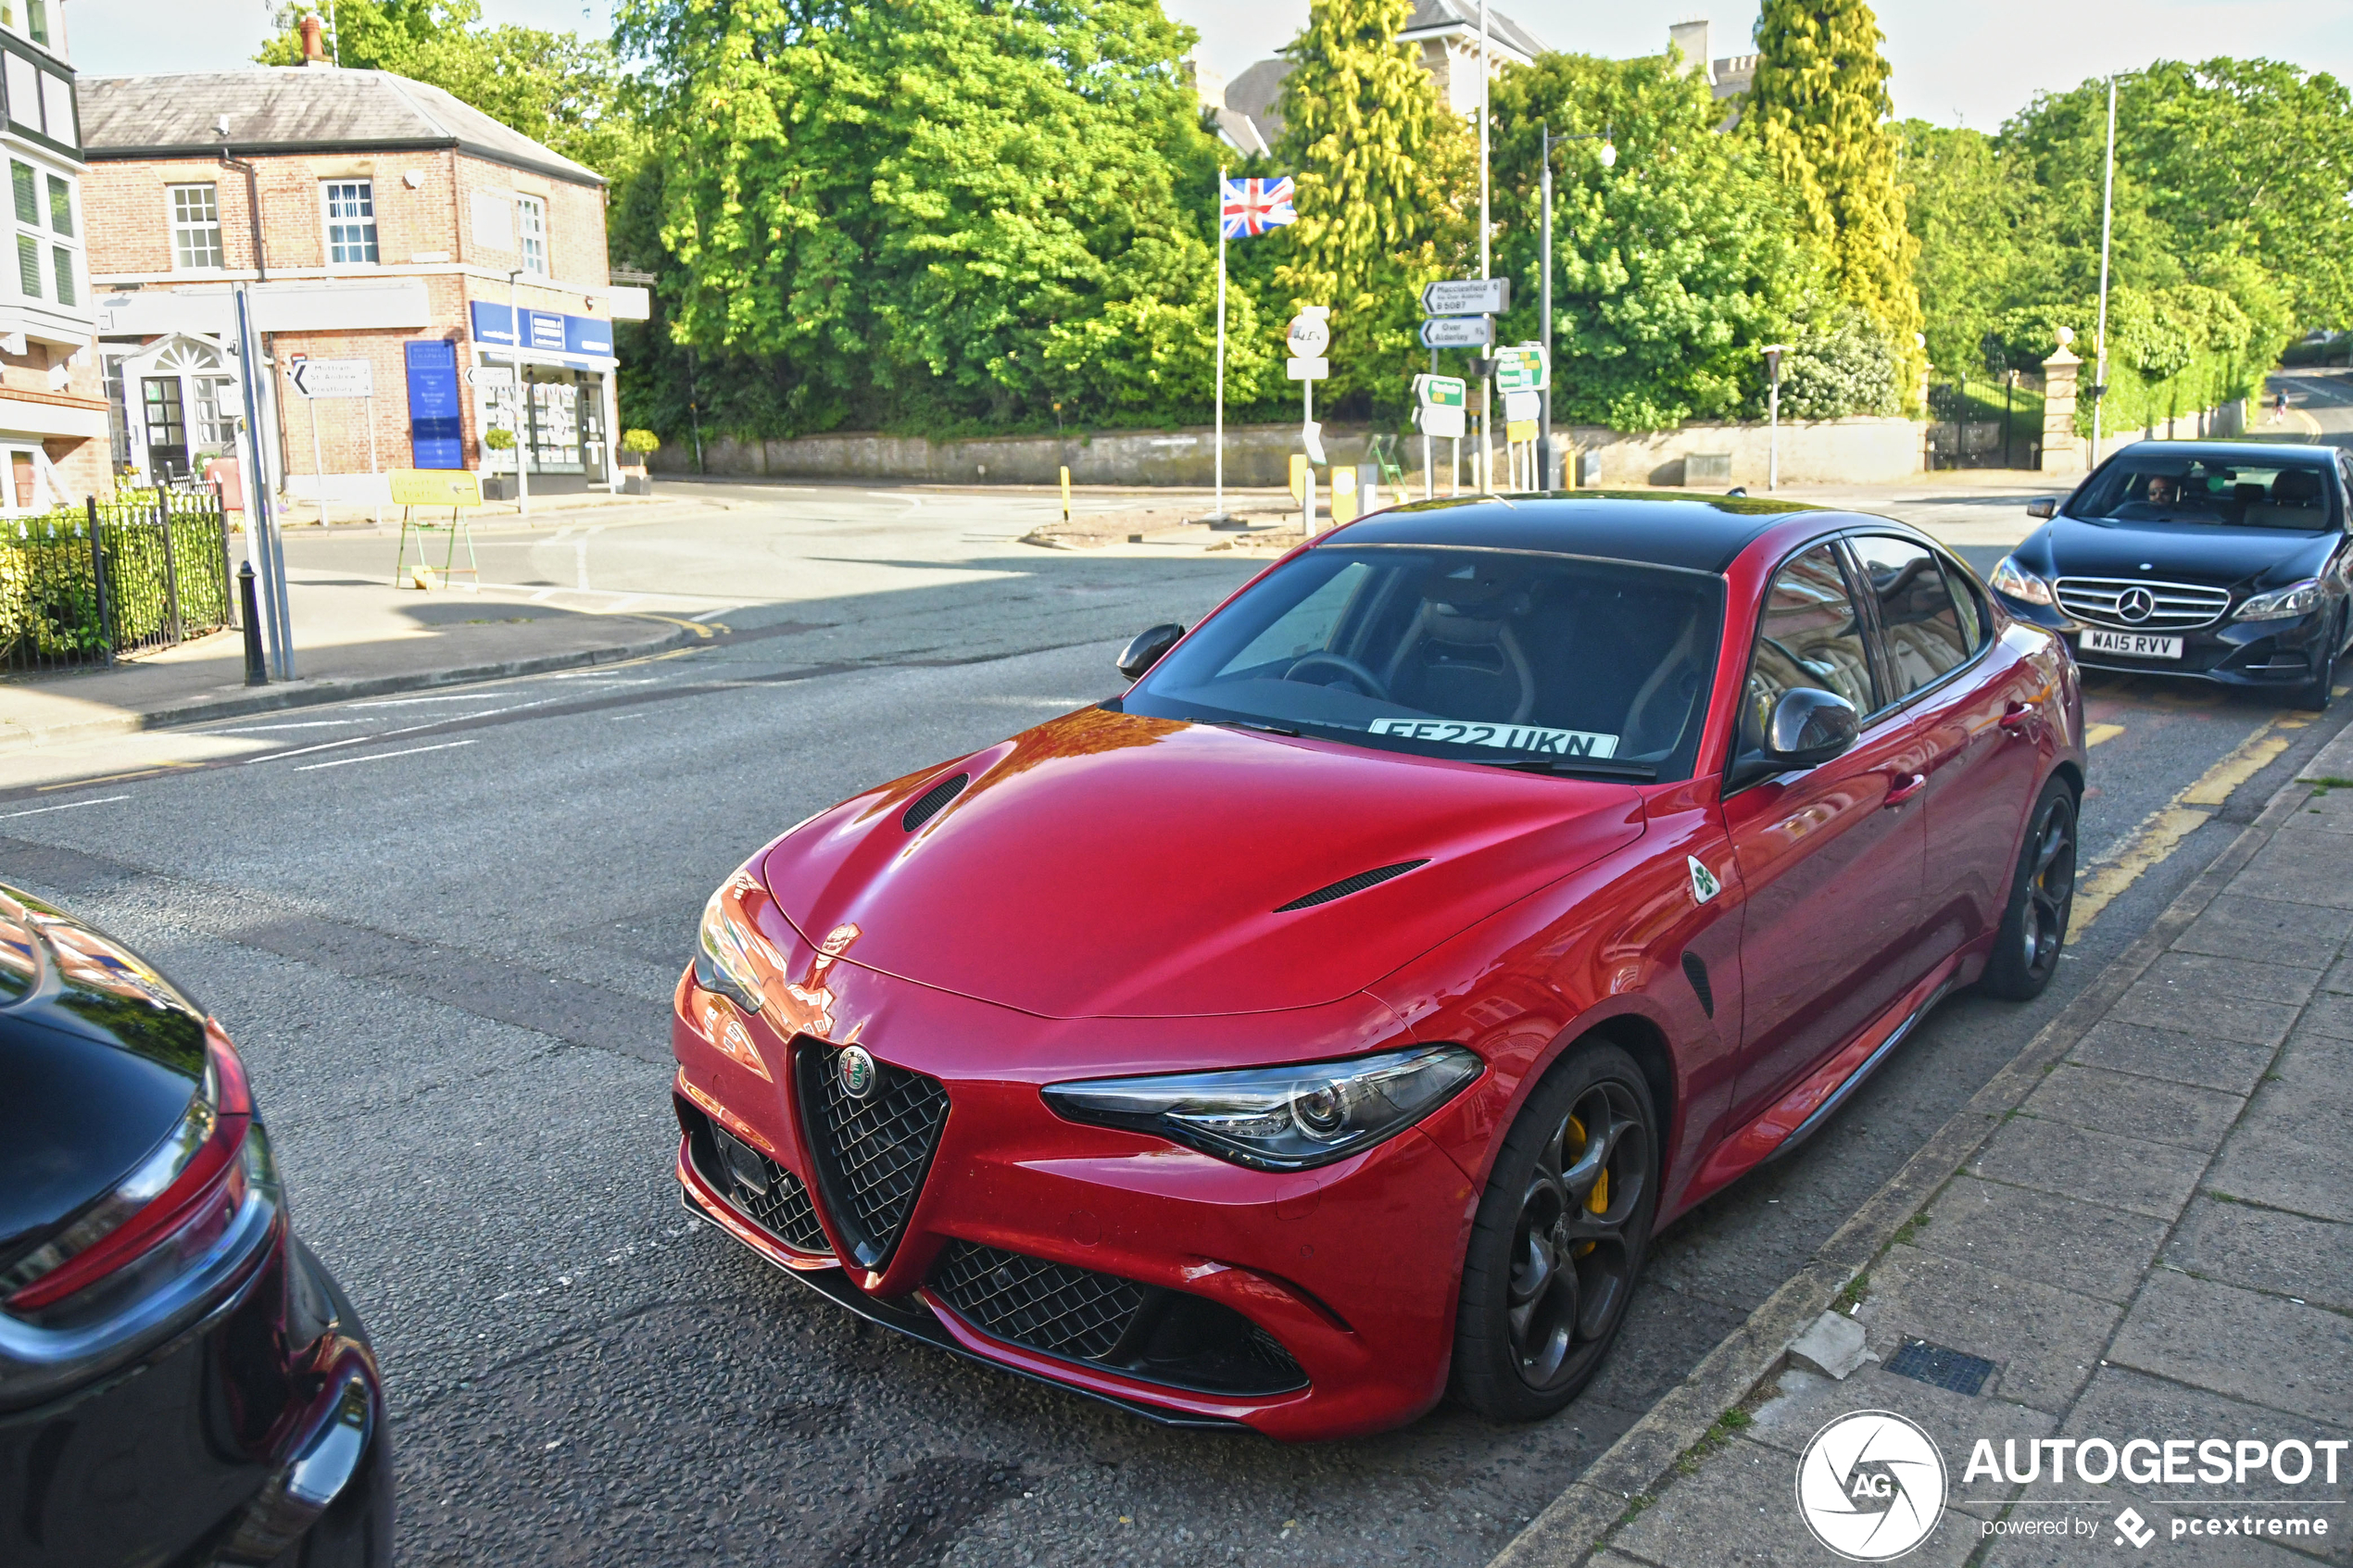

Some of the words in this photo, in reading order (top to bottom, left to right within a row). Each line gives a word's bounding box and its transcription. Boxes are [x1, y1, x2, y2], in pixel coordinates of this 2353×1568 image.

[1437, 283, 1488, 294] Macclesfield
[1444, 300, 1466, 310] 5087
[1441, 323, 1462, 332] Over
[1435, 332, 1469, 342] Alderley
[2093, 632, 2131, 650] WA15
[2135, 637, 2172, 654] RVV
[1504, 729, 1596, 756] UKN
